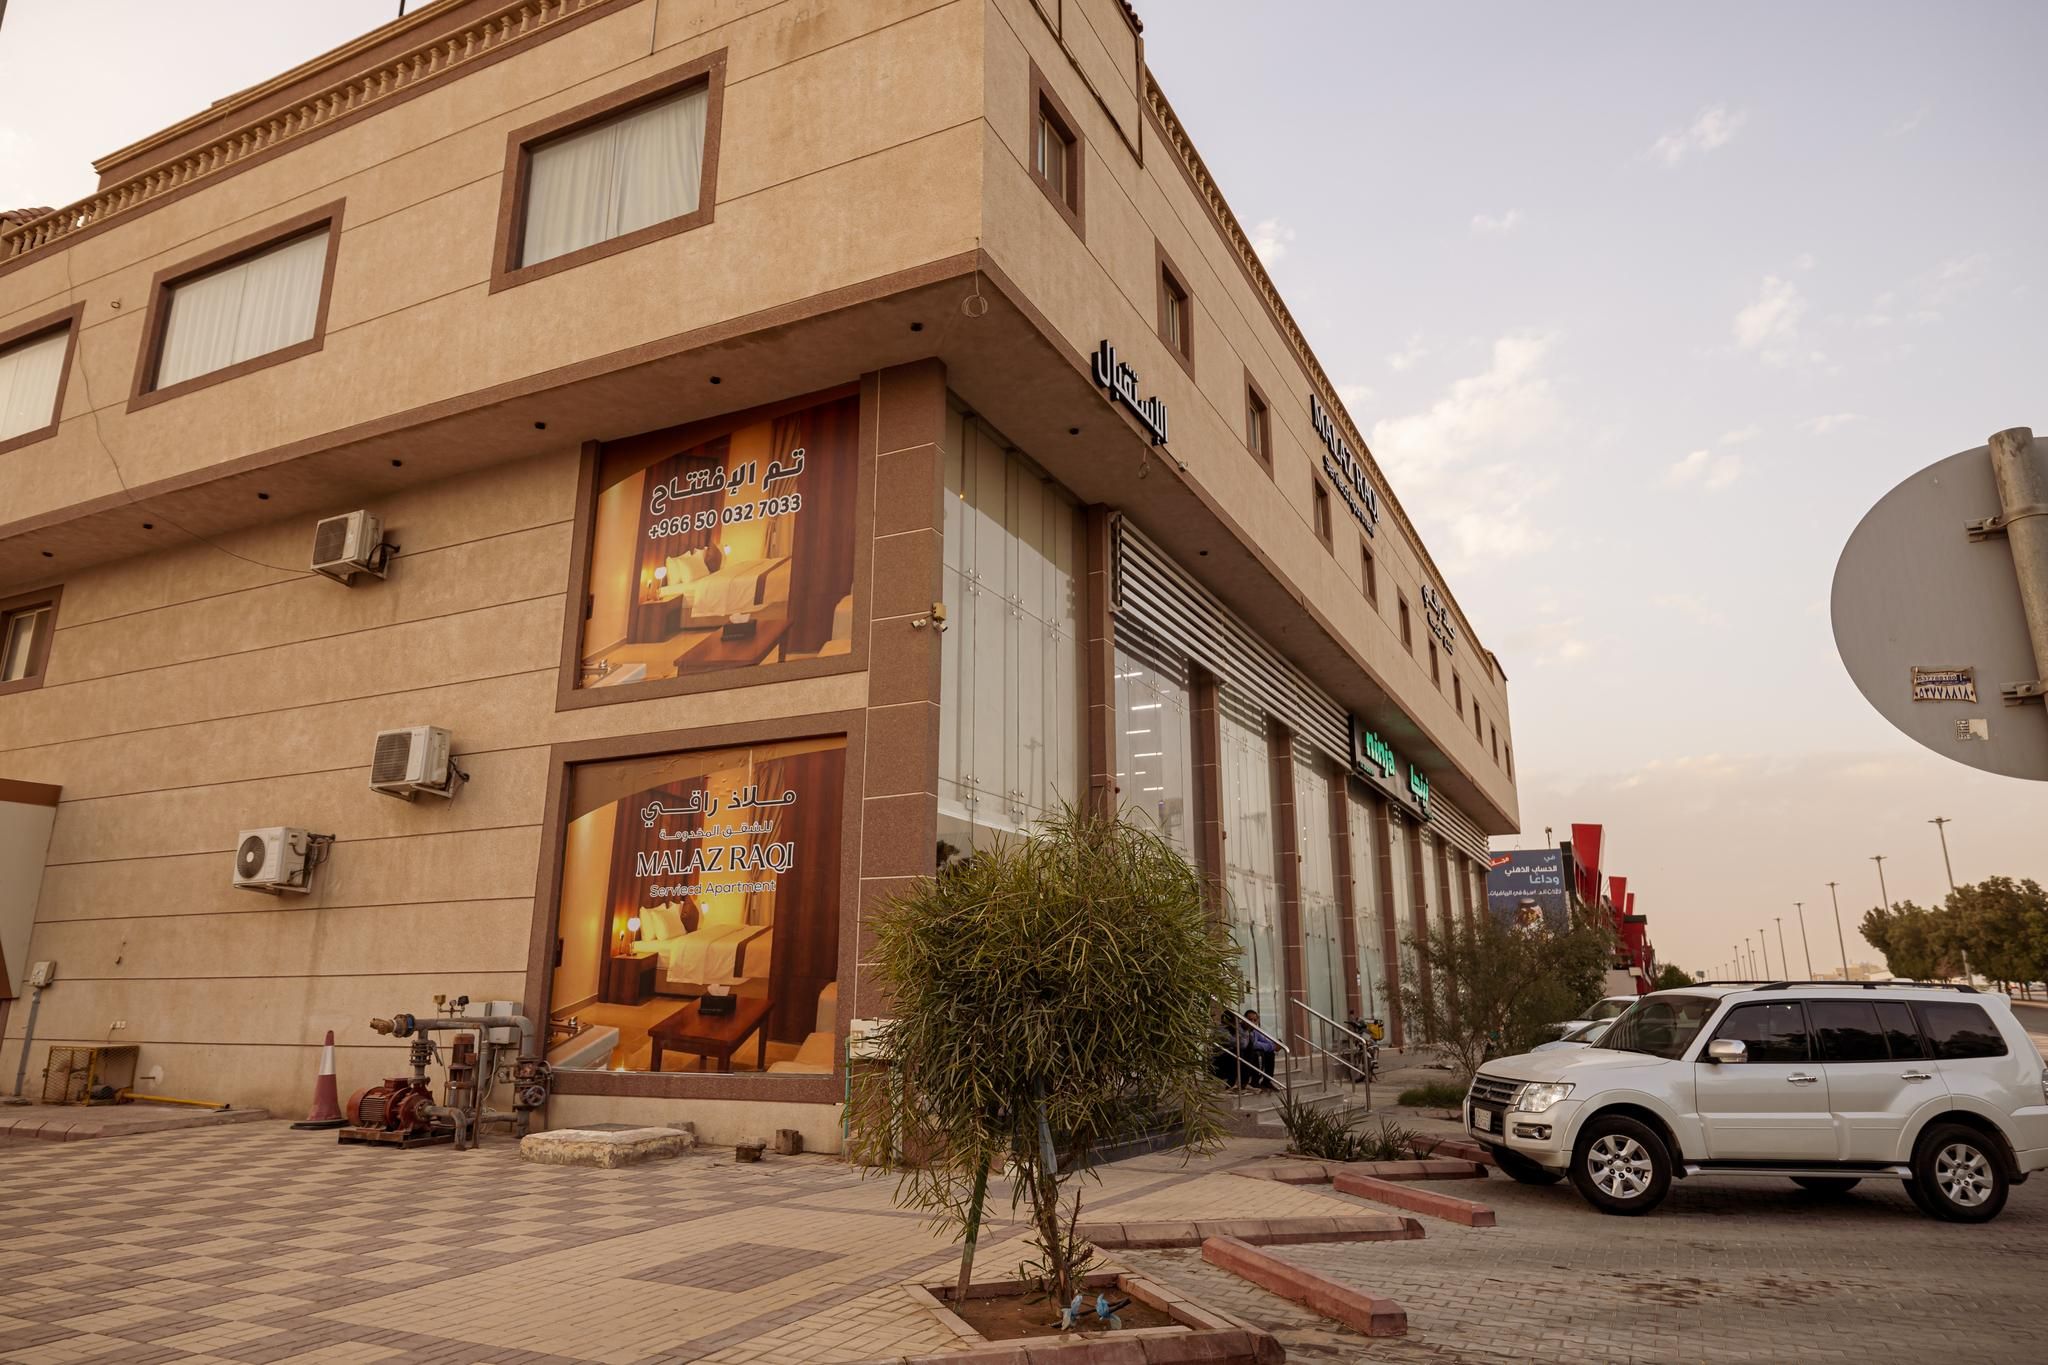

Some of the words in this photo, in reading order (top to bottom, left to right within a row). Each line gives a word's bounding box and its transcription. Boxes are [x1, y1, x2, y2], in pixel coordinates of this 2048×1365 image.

[1310, 394, 1355, 484] MALAZ
[650, 460, 756, 515] الإفتتاح
[763, 448, 805, 491] تم
[649, 515, 690, 539] +966
[694, 510, 717, 530] 50
[722, 504, 754, 525] 032
[758, 493, 802, 518] 7033
[1364, 731, 1396, 778] ninja
[641, 789, 718, 828] راقي
[727, 785, 797, 810] ملاذ
[659, 824, 720, 842] المخدومة
[722, 819, 774, 839] للشقق
[636, 846, 724, 877] MALAZ
[728, 841, 795, 874] RAQI
[705, 879, 777, 897] Apartment
